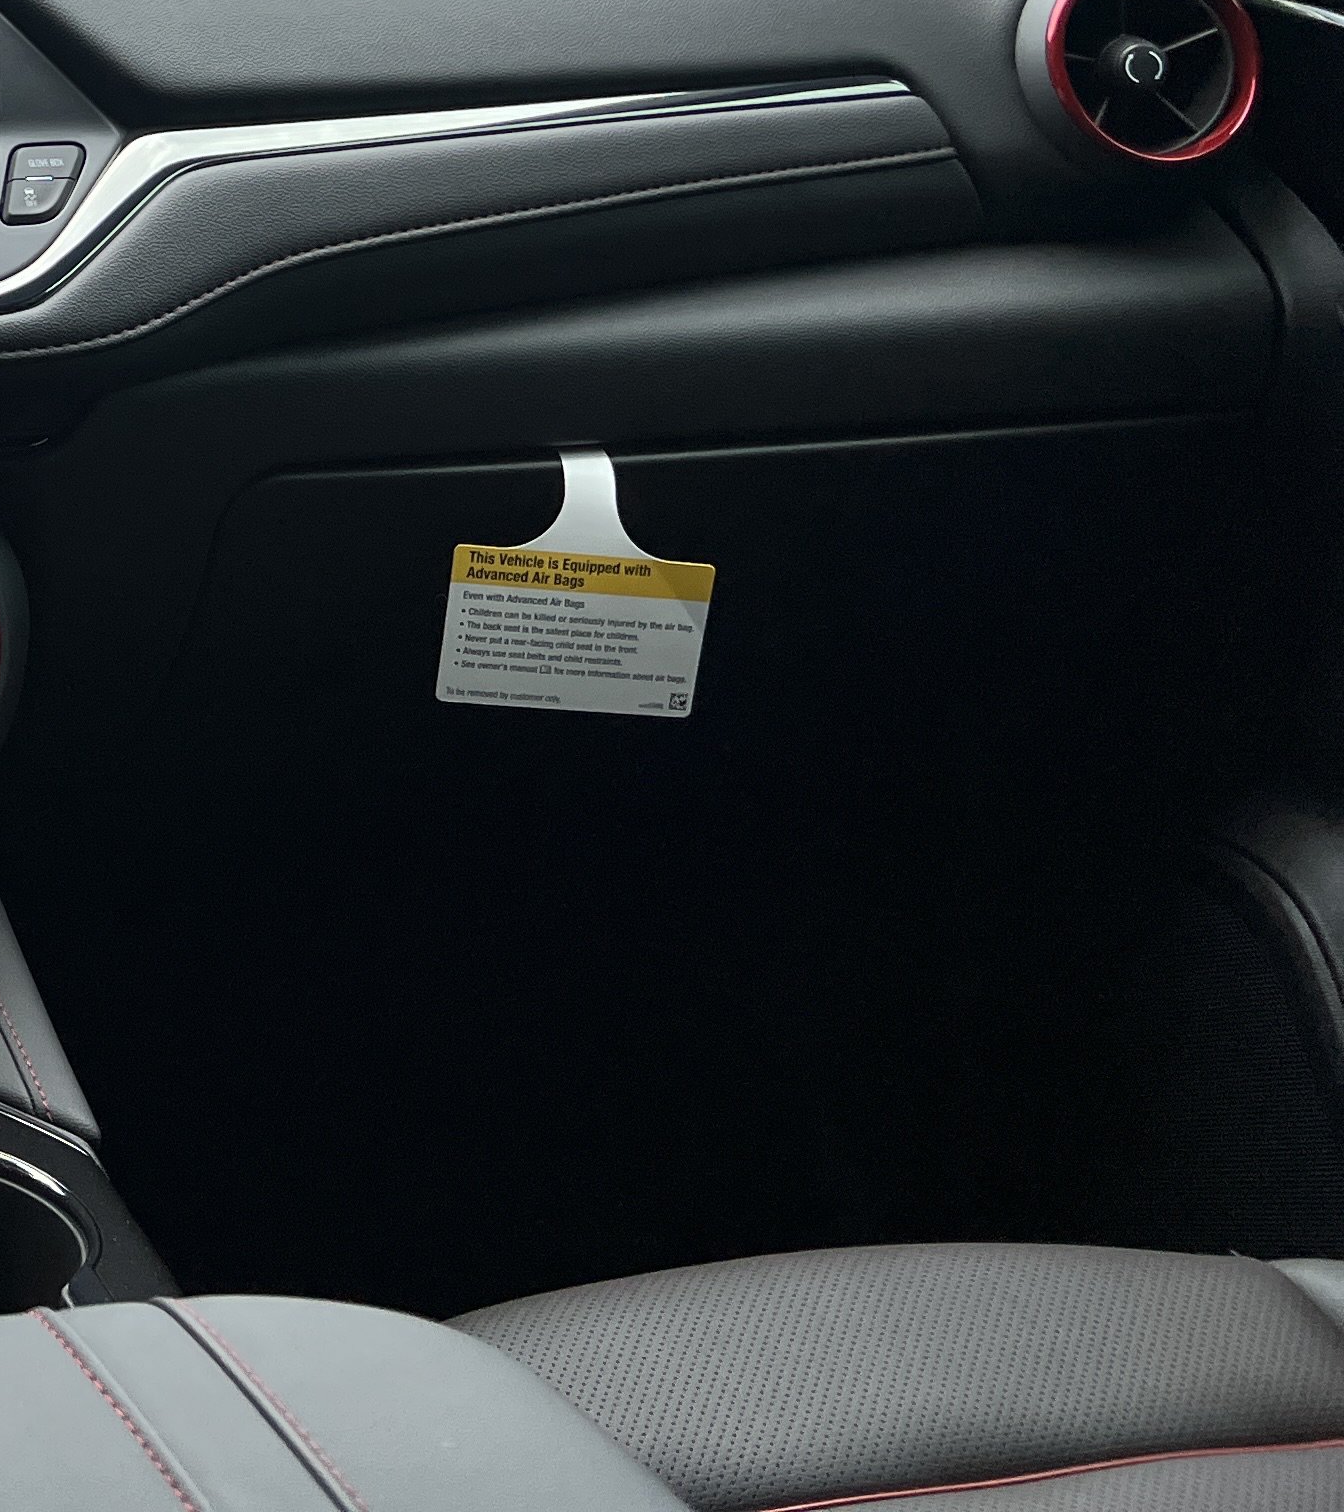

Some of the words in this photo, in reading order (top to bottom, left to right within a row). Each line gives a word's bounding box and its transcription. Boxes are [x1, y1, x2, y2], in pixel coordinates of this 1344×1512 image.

[27, 158, 48, 168] GLOVE
[469, 551, 495, 565] This
[499, 553, 545, 568] Vehicle
[548, 557, 559, 569] is
[563, 558, 621, 576] Equipped
[624, 564, 652, 577] with
[466, 566, 528, 582] Advanced
[531, 572, 550, 584] Air
[554, 574, 585, 589] Bags
[463, 590, 484, 600] Even
[485, 593, 505, 602] with
[506, 594, 548, 606] Advanced
[550, 598, 562, 606] Air
[564, 599, 585, 610] Bags
[467, 620, 481, 629] The
[483, 622, 502, 631] back
[531, 626, 544, 634] the
[570, 629, 592, 638] place
[593, 630, 605, 638] for
[468, 608, 502, 618] Children
[504, 611, 519, 619] can
[521, 611, 532, 620] be
[534, 613, 556, 622] killed
[569, 617, 605, 627] seriously
[607, 619, 636, 628] injured
[638, 621, 647, 631] by
[650, 622, 663, 630] the
[464, 634, 487, 643] Never
[489, 637, 502, 645] put
[555, 641, 575, 649] child
[604, 644, 616, 652] the
[462, 647, 490, 657] Always
[492, 650, 507, 658] use
[527, 652, 546, 661] belts
[547, 654, 562, 662] and
[564, 655, 582, 663] child
[461, 660, 475, 668] See
[477, 662, 508, 671] owner's
[509, 664, 538, 673] manual
[566, 668, 585, 677] more
[587, 669, 630, 679] information
[632, 673, 653, 681] about
[466, 689, 498, 699] removed
